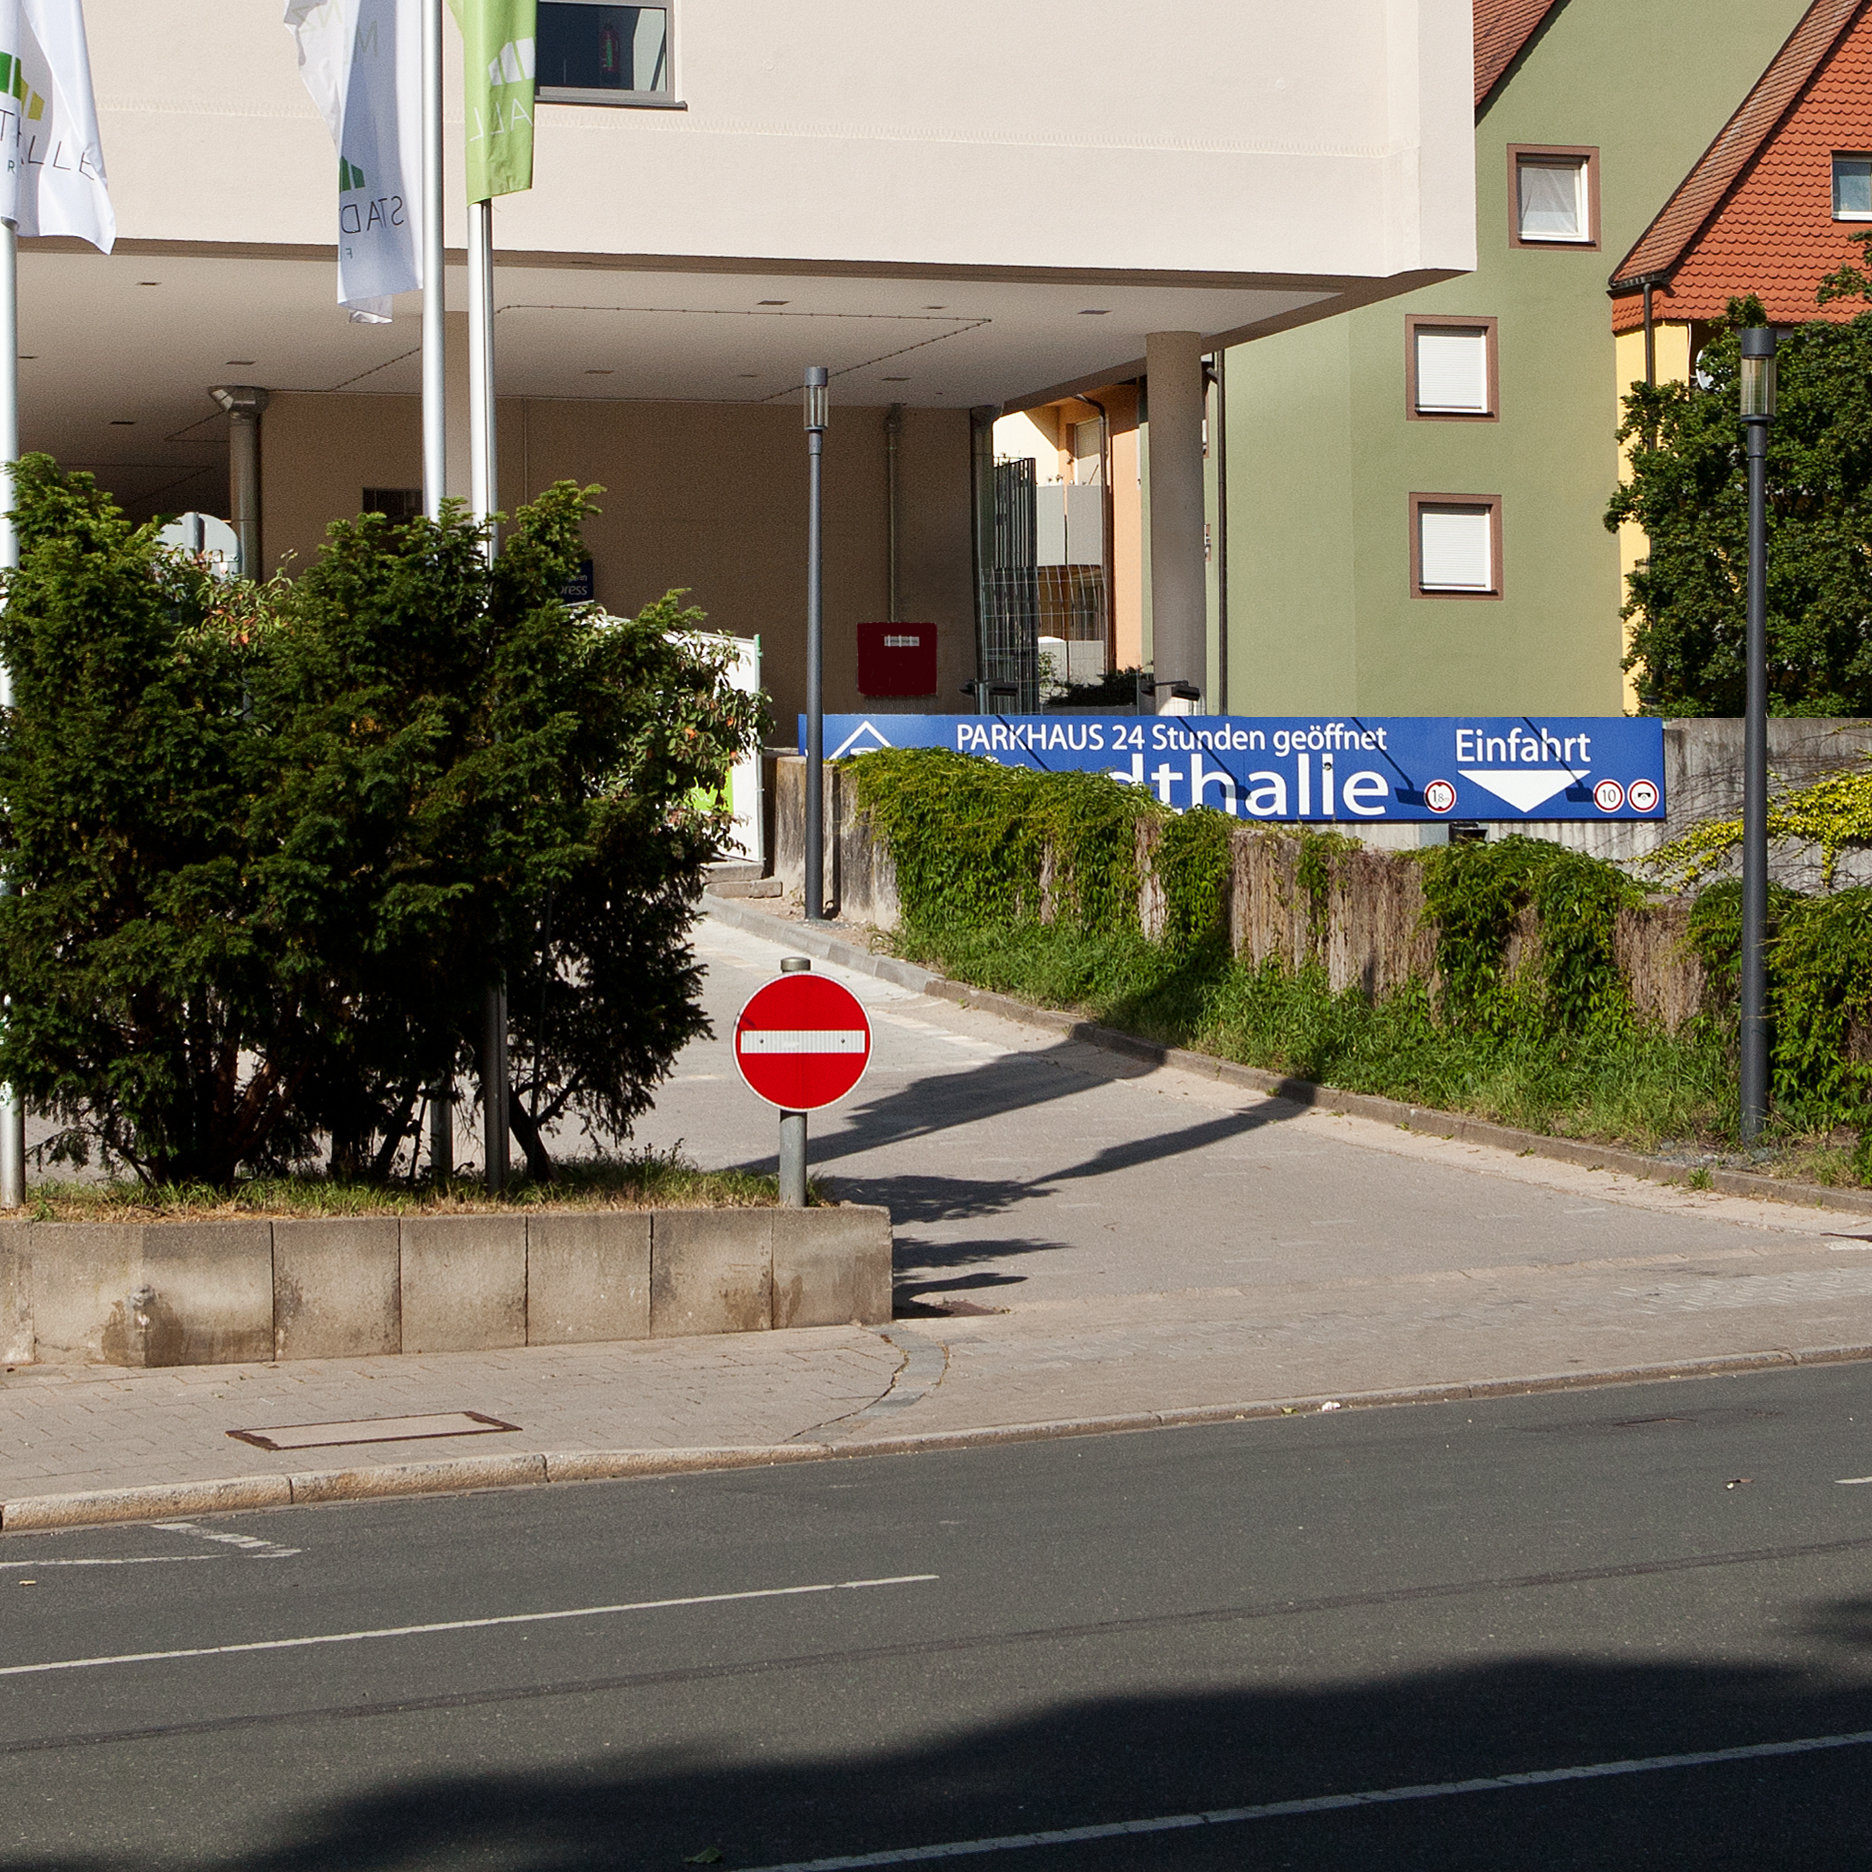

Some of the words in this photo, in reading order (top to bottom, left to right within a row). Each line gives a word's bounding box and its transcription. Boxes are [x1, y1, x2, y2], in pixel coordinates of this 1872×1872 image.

[956, 723, 1105, 751] PARKHAUS
[1111, 724, 1145, 751] 24
[1151, 723, 1266, 751] Stunden
[1273, 722, 1388, 757] geöffnet
[1455, 727, 1592, 763] Einfahrt
[1602, 789, 1617, 804] 10
